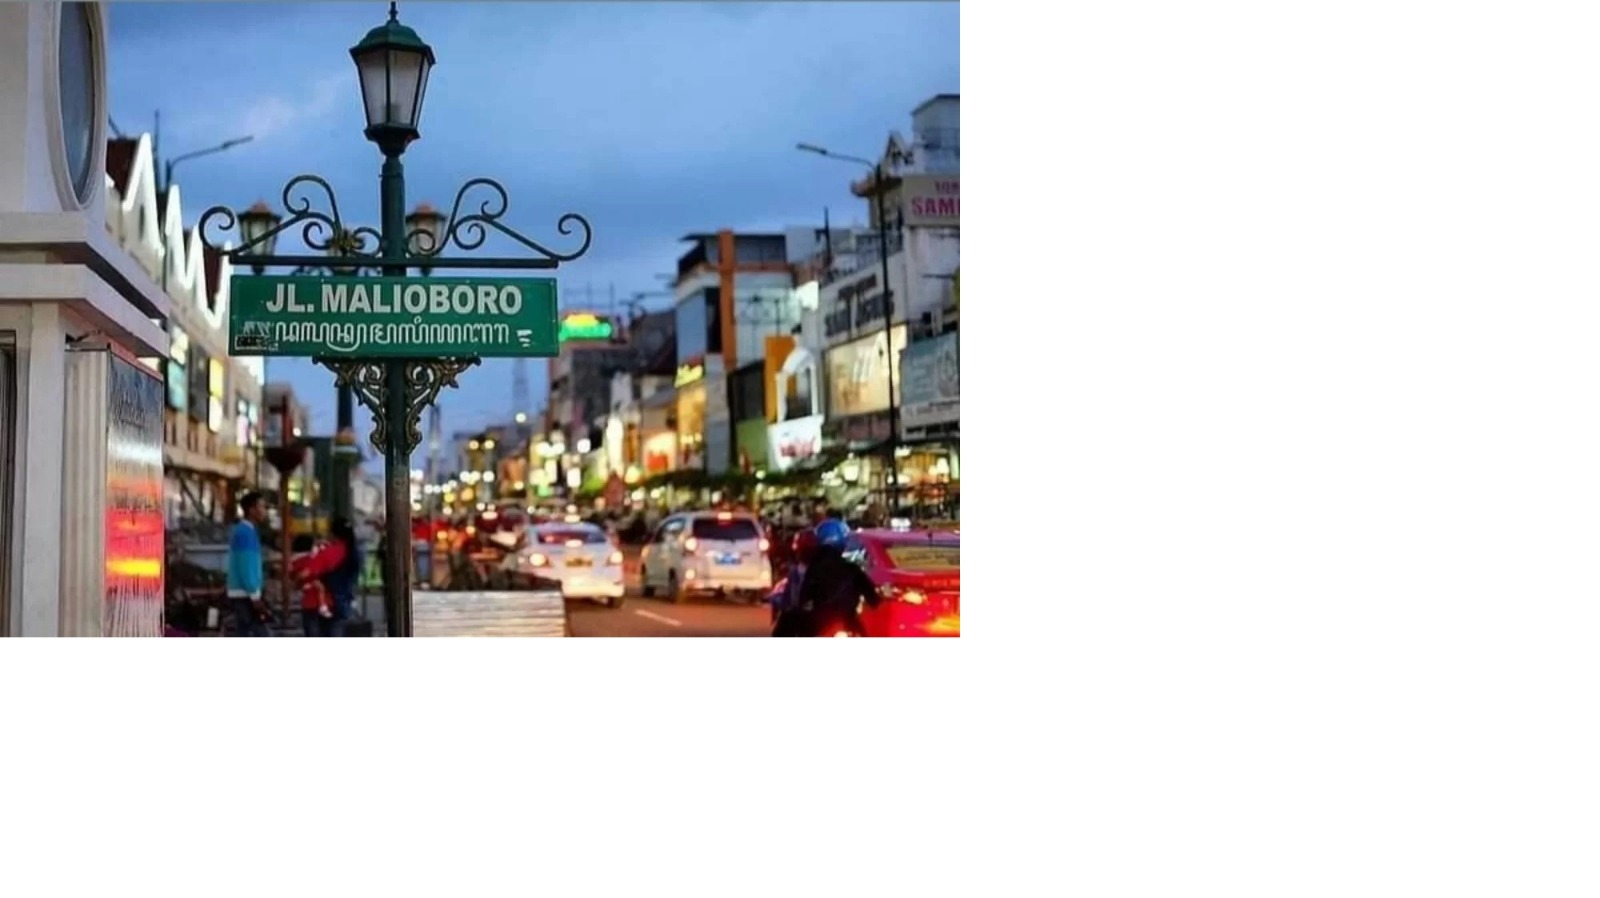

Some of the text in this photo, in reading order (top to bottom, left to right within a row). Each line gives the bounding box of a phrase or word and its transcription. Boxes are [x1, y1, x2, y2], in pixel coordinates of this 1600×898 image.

[911, 196, 960, 216] SAM
[266, 283, 522, 315] JL. MALIOBORO
